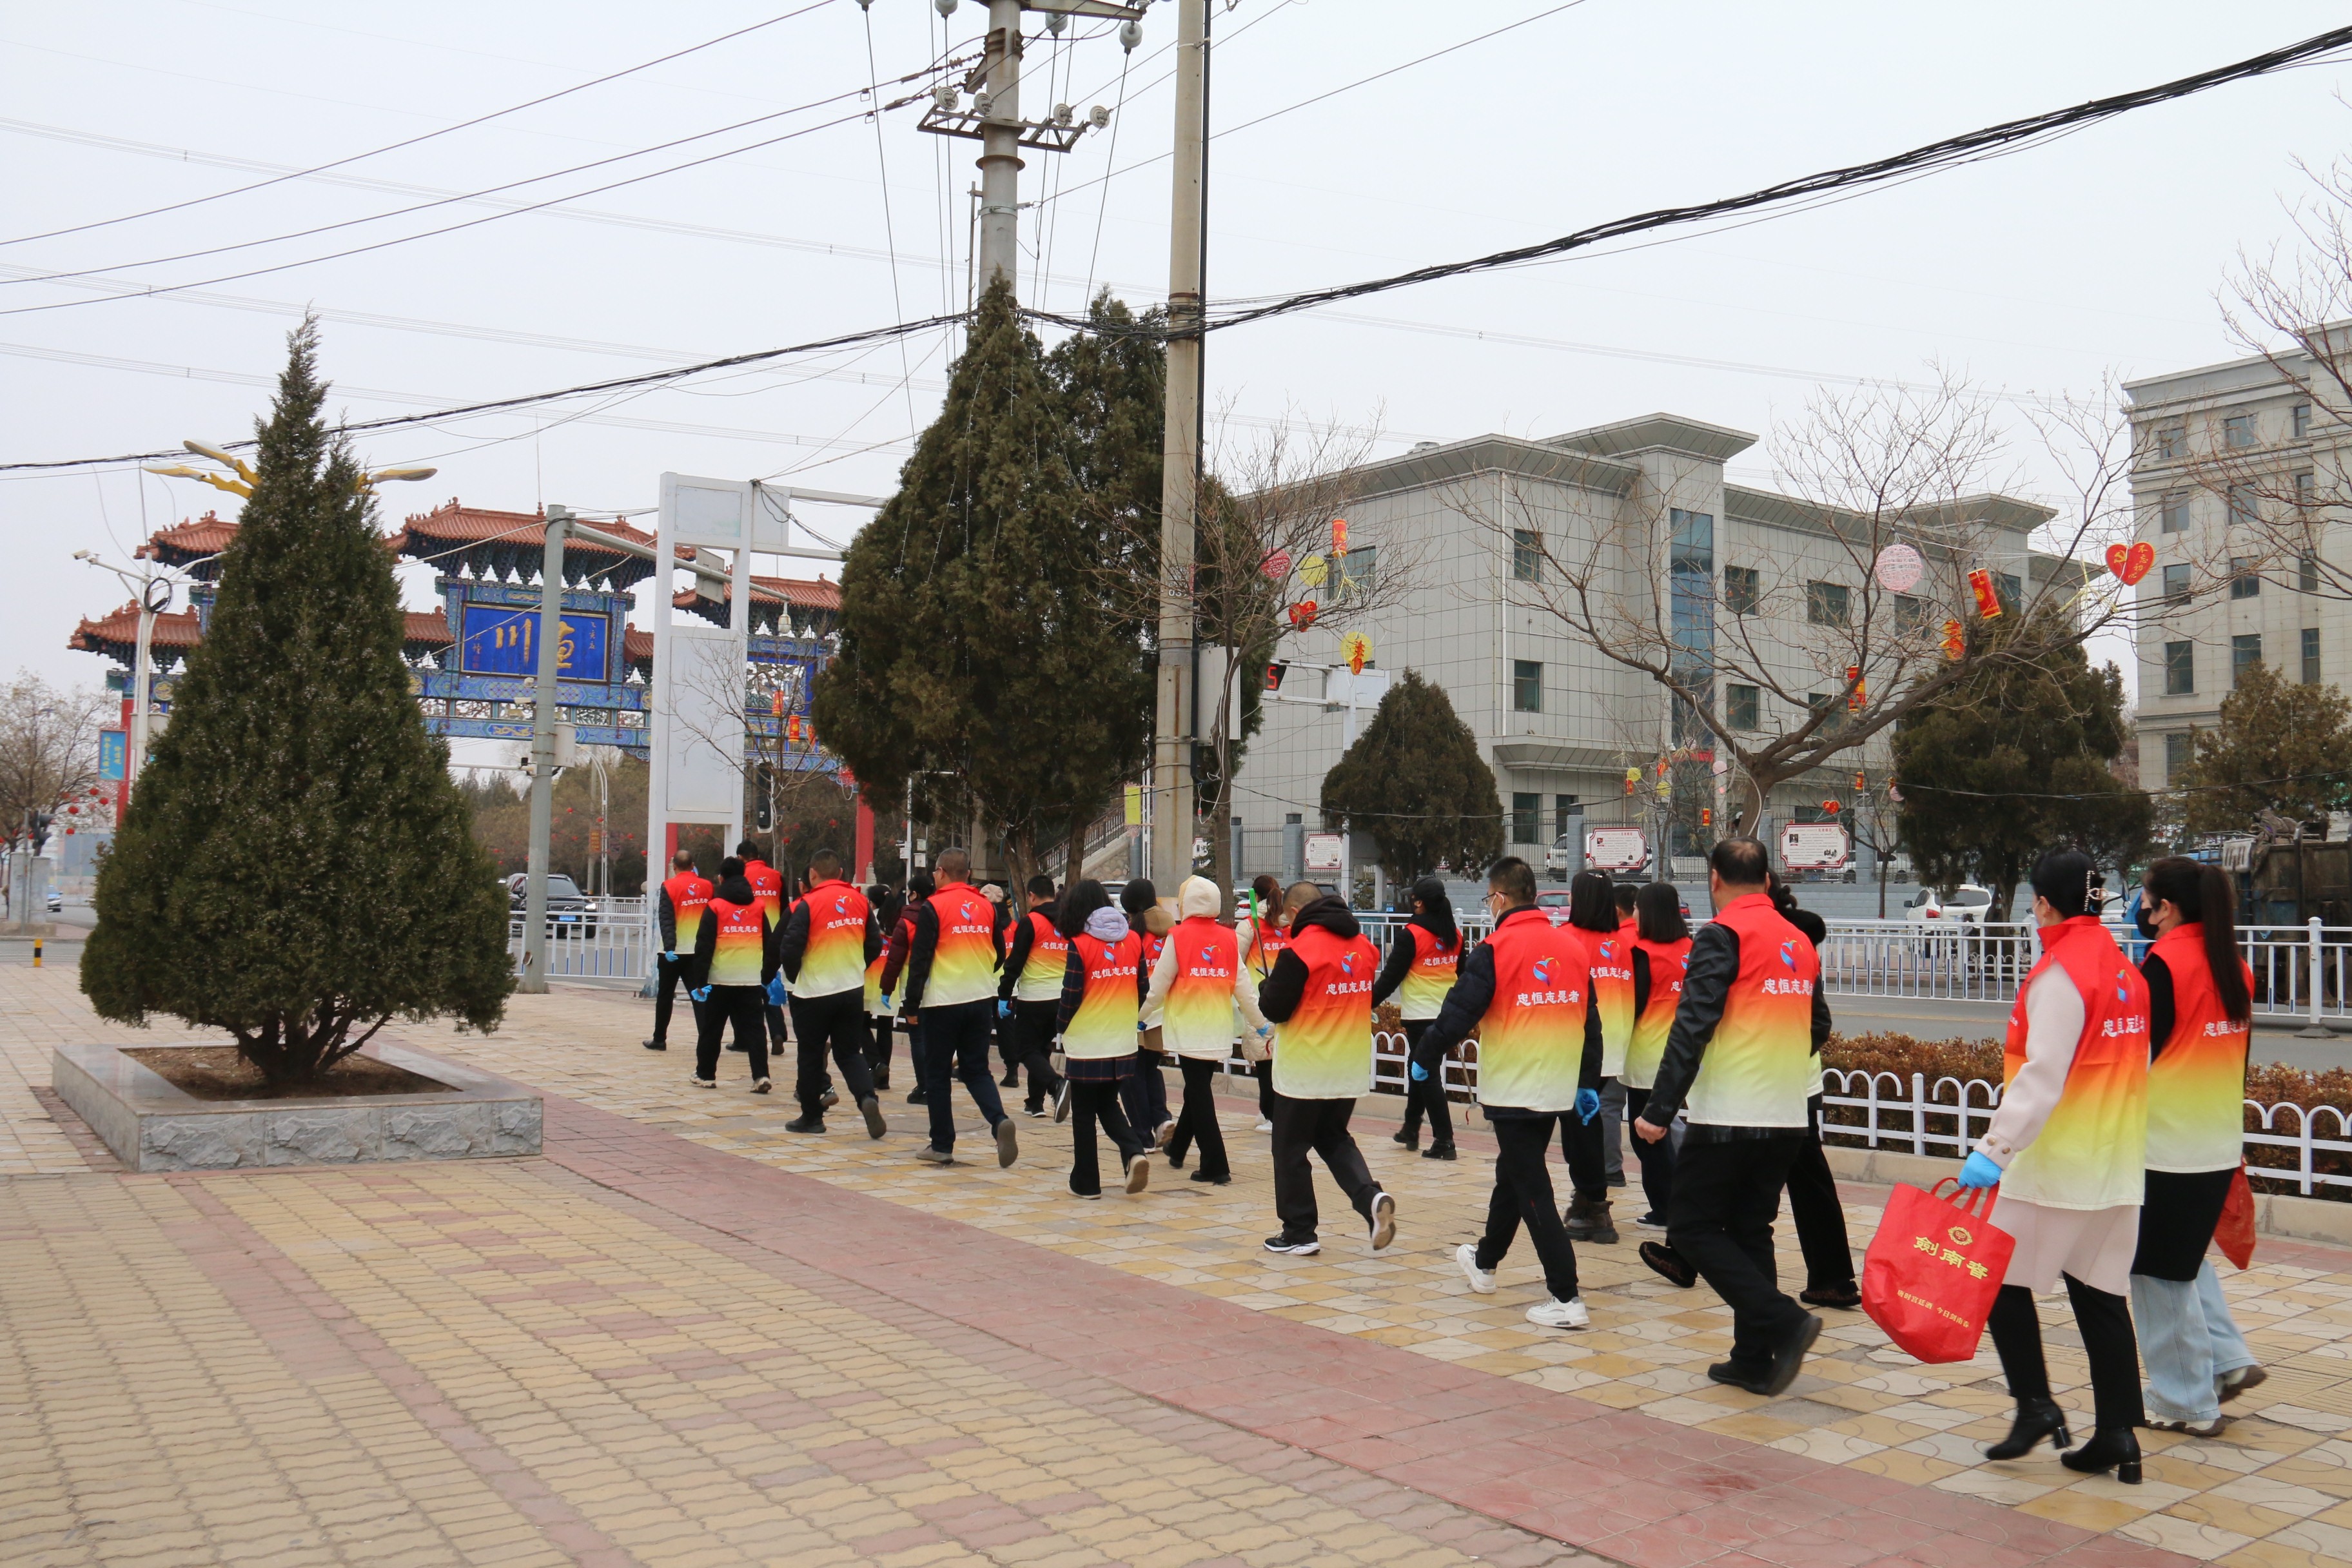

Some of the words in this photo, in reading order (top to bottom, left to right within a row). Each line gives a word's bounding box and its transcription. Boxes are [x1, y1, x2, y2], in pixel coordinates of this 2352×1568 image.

[1897, 1289, 1934, 1310] 唐时宫廷酒
[1936, 1307, 1970, 1328] 今日剑南春
